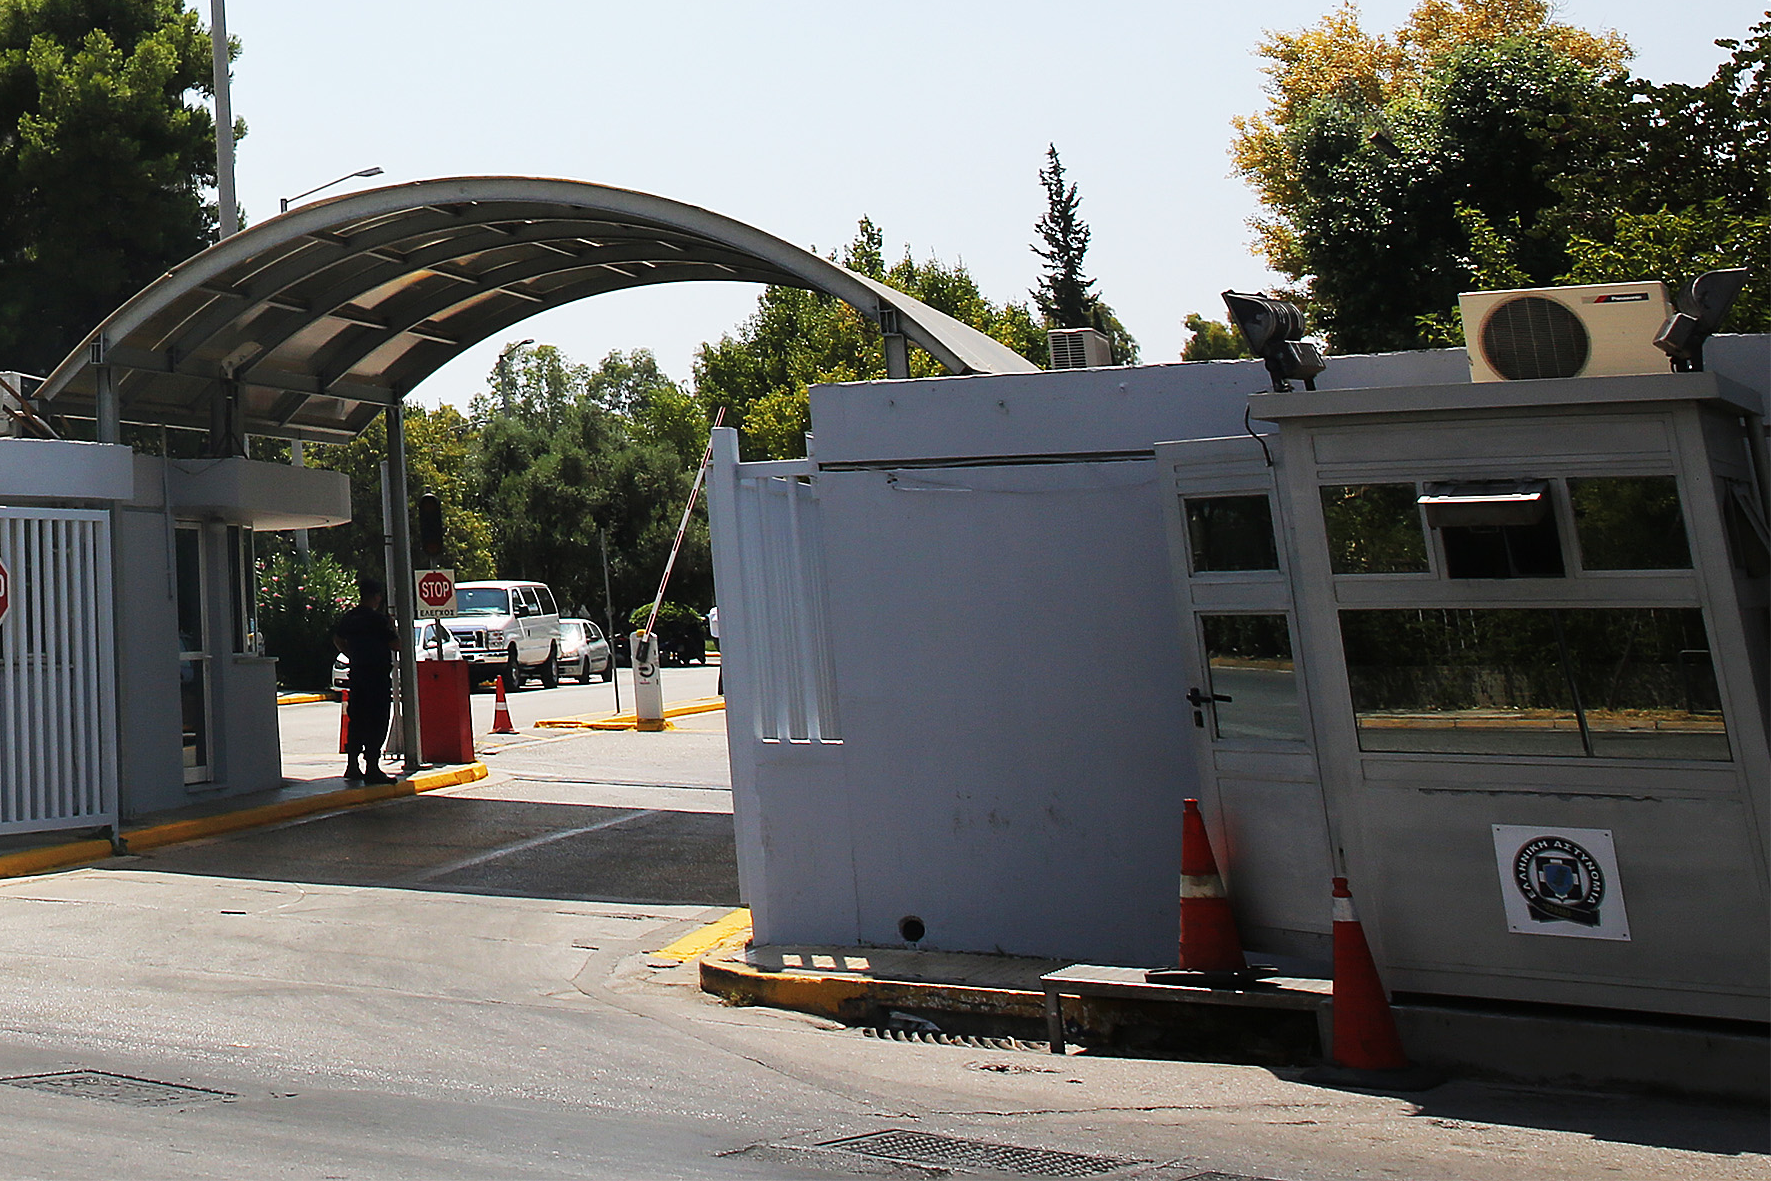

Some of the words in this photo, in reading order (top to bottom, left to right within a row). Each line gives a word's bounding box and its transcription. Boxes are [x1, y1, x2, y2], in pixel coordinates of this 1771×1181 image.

[421, 581, 450, 598] STOP
[419, 609, 454, 617] ΕΛΕΓΧΟΣ
[1518, 840, 1548, 900] ΕΛΛΗΝΙΚΗ
[1553, 840, 1601, 905] ΑΣΤΥΝΟΜΙΑ
